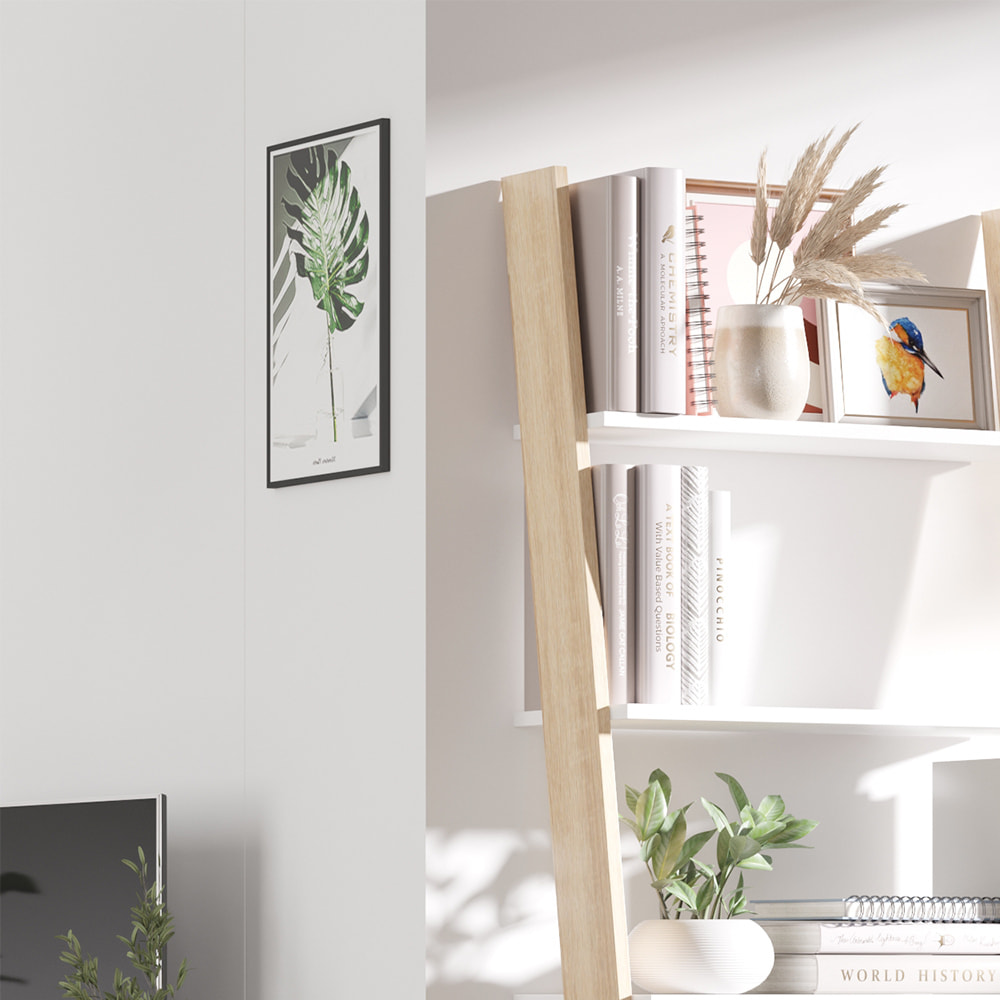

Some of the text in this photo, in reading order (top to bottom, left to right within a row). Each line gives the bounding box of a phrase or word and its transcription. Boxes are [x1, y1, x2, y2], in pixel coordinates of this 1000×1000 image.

[616, 287, 624, 317] MILNE
[668, 252, 678, 356] CHEMISTRY
[654, 521, 663, 653] With Value Based Questions
[665, 503, 676, 671] A TEXT BOOK OF BIOLOGY
[715, 557, 724, 643] PINOCCHIO
[840, 968, 997, 983] WORLD HISTORY
